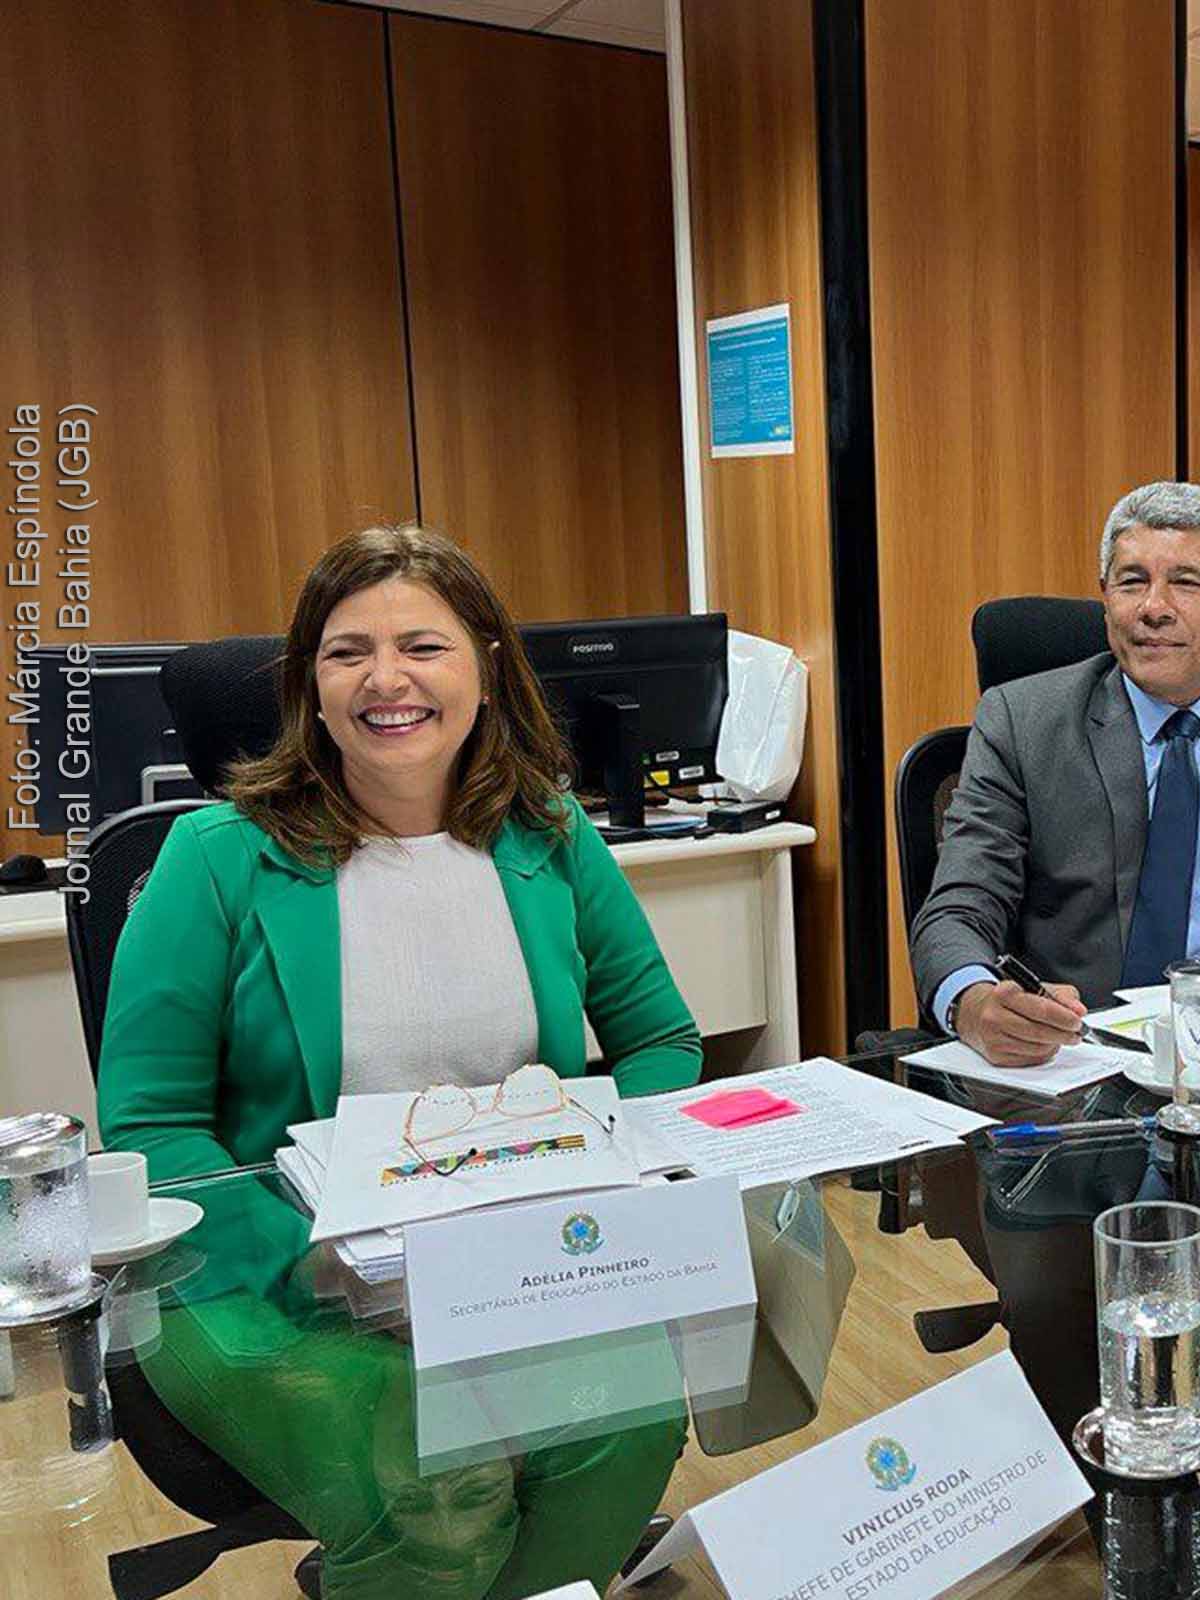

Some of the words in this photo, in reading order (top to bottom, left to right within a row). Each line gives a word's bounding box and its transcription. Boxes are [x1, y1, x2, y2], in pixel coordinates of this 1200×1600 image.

[578, 1257, 650, 1279] PINHEIRO
[602, 1279, 620, 1290] DO
[829, 1559, 856, 1584] DE
[855, 1514, 933, 1569] GABINETE
[931, 1501, 958, 1525] DO
[956, 1461, 1027, 1511] MINISTRO
[1025, 1448, 1048, 1471] DE
[842, 1493, 926, 1547] VINICIUS
[923, 1467, 972, 1501] RODA
[845, 1555, 910, 1600] ESTADO
[909, 1542, 936, 1566] DA
[933, 1495, 1012, 1552] EDUCAÇÃO
